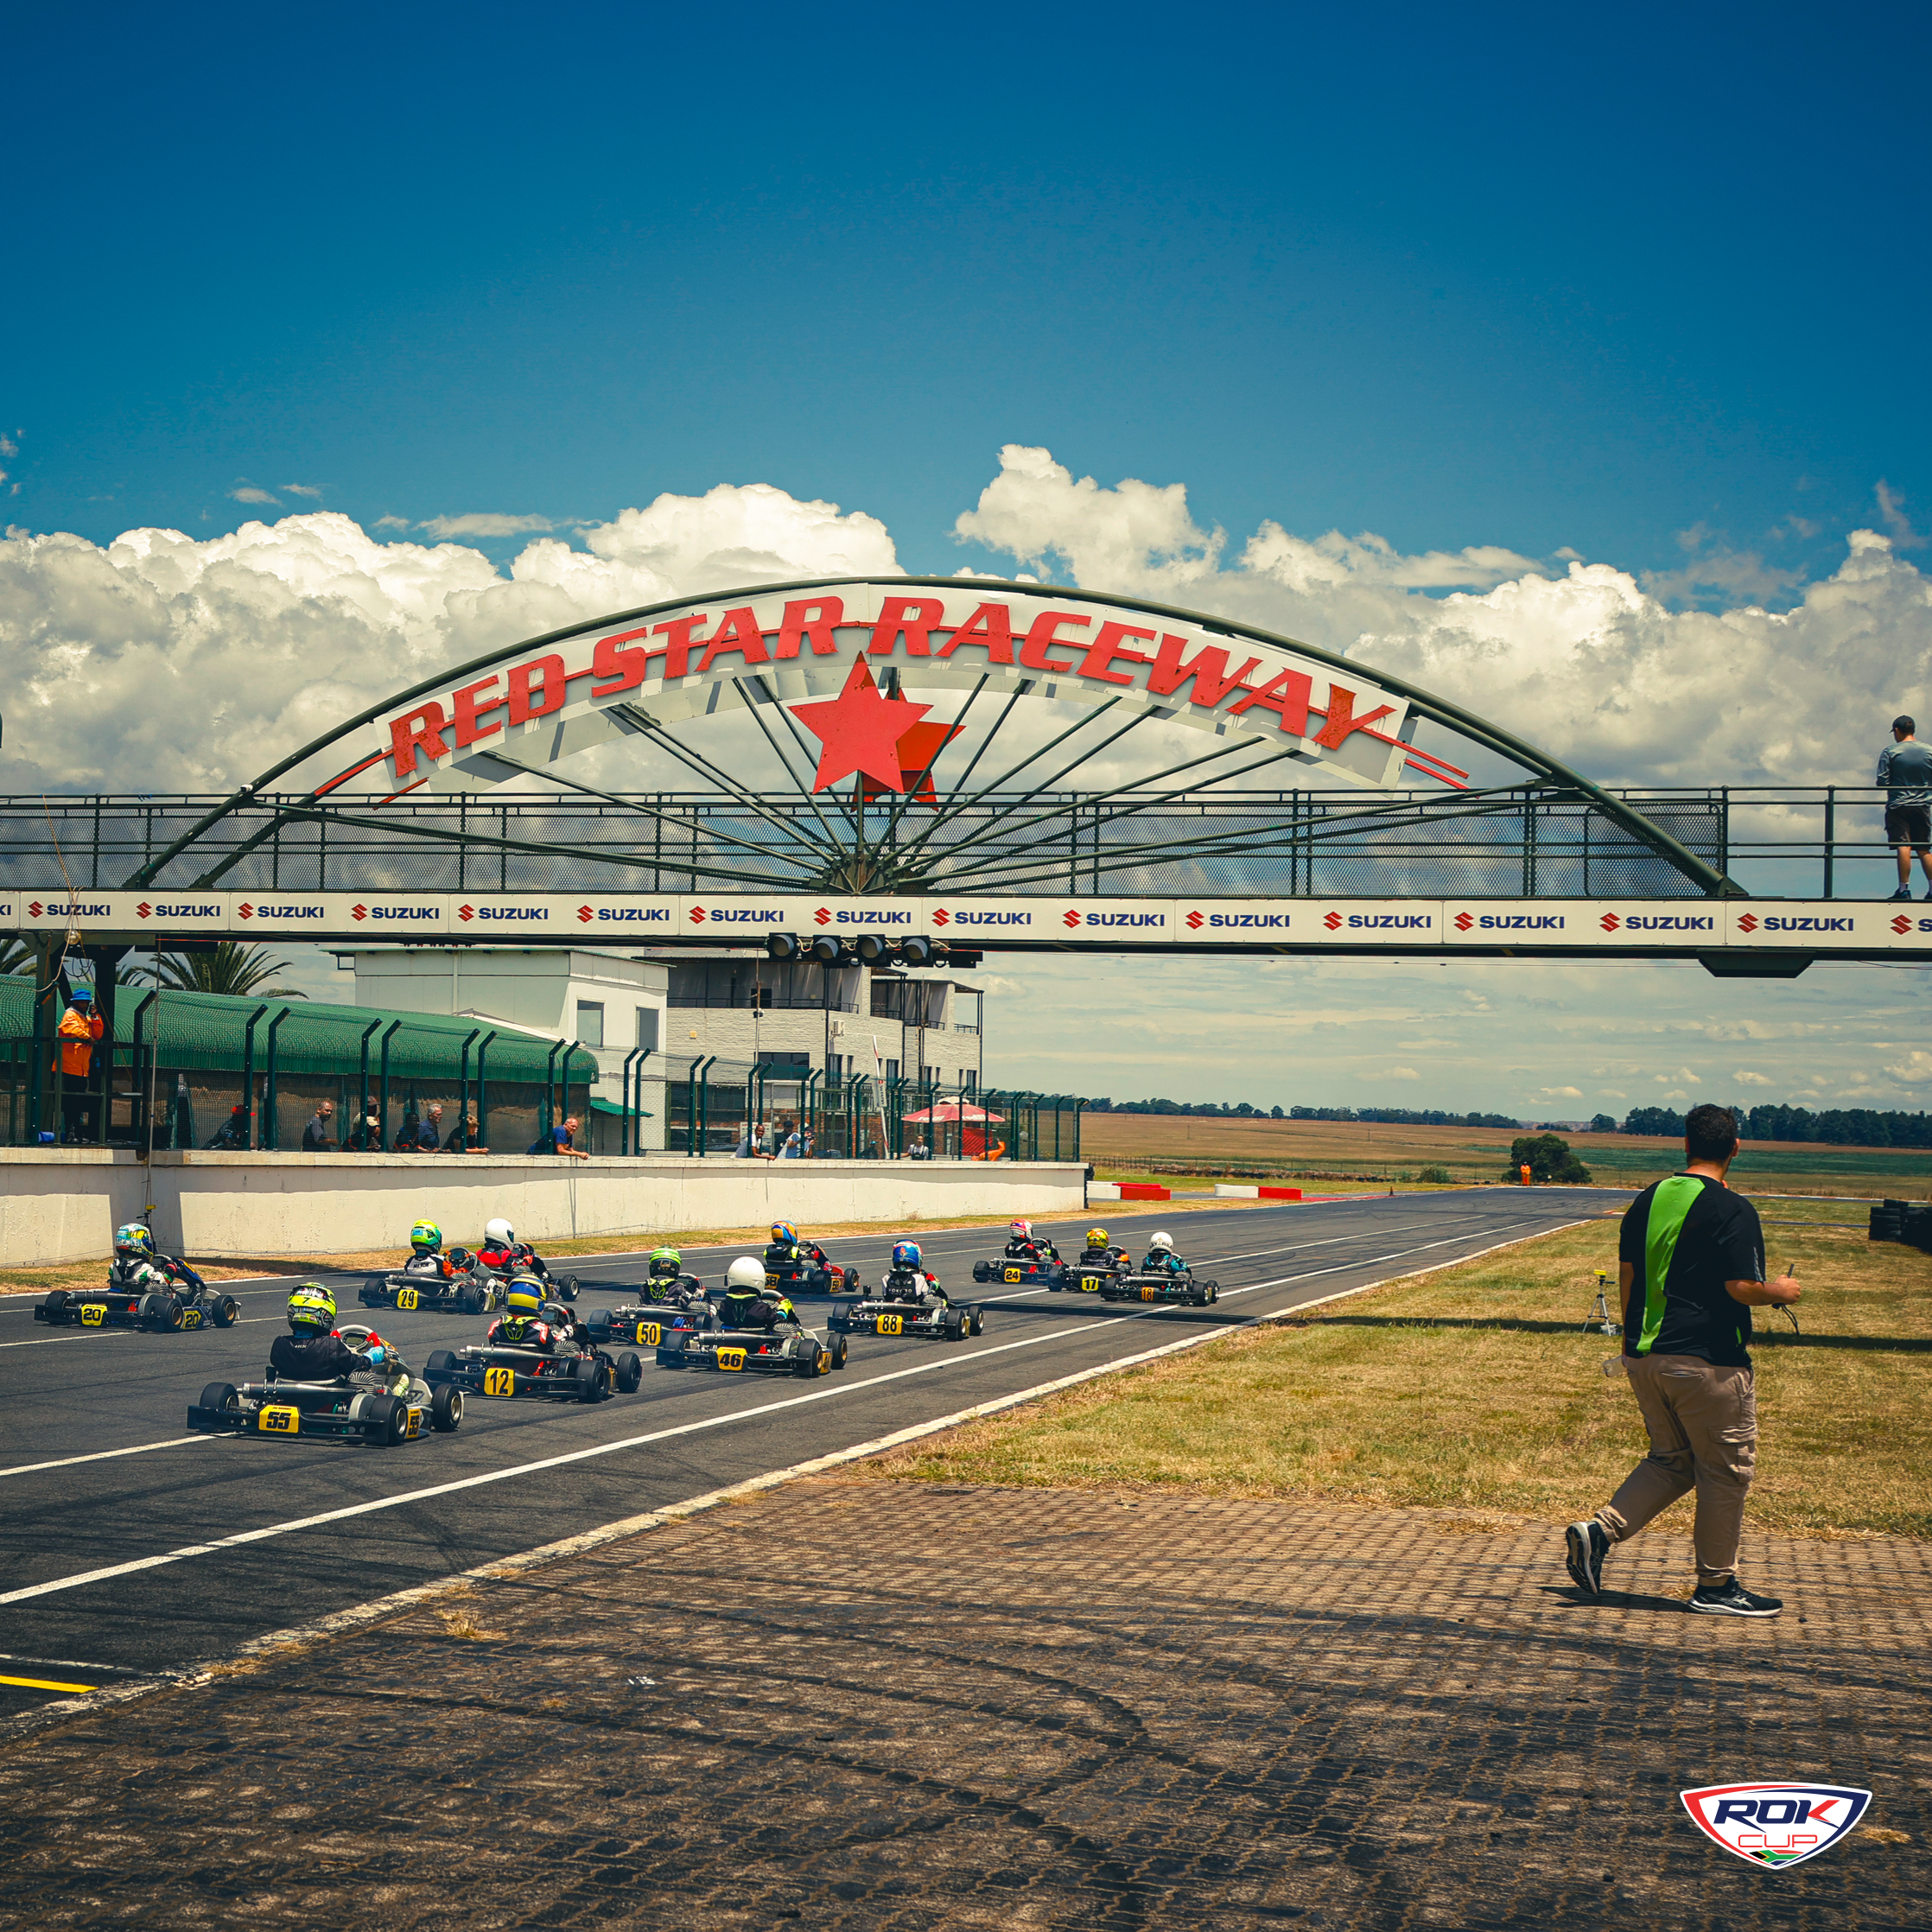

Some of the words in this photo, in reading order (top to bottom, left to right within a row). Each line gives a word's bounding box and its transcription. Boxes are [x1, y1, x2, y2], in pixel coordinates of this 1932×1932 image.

[388, 653, 567, 779] RED
[591, 595, 845, 698] STAR
[865, 596, 1397, 752] RACEWAY
[47, 905, 111, 916] SUZUKI
[156, 906, 220, 917] SUZUKI
[257, 906, 325, 918] SUZUKI
[372, 907, 440, 919] SUZUKI
[479, 908, 550, 920] SUZUKI
[598, 909, 670, 921] SUZUKI
[711, 910, 785, 922] SUZUKI
[836, 912, 912, 924] SUZUKI
[955, 912, 1032, 925] SUZUKI
[1086, 913, 1166, 926] SUZUKI
[1210, 914, 1291, 927] SUZUKI
[1349, 915, 1432, 928] SUZUKI
[1479, 916, 1566, 929] SUZUKI
[1626, 917, 1714, 930] SUZUKI
[1764, 918, 1854, 931] SUZUKI
[1006, 1270, 1019, 1281] 24
[1084, 1279, 1096, 1290] 17
[401, 1291, 415, 1307] 29
[1142, 1288, 1153, 1300] 18
[84, 1308, 101, 1321] 20
[185, 1313, 198, 1327] 20
[882, 1315, 898, 1332] 88
[640, 1325, 657, 1344] 50
[720, 1353, 741, 1367] 46
[490, 1370, 509, 1395] 12
[266, 1411, 291, 1430] 55
[408, 1415, 420, 1436] 55
